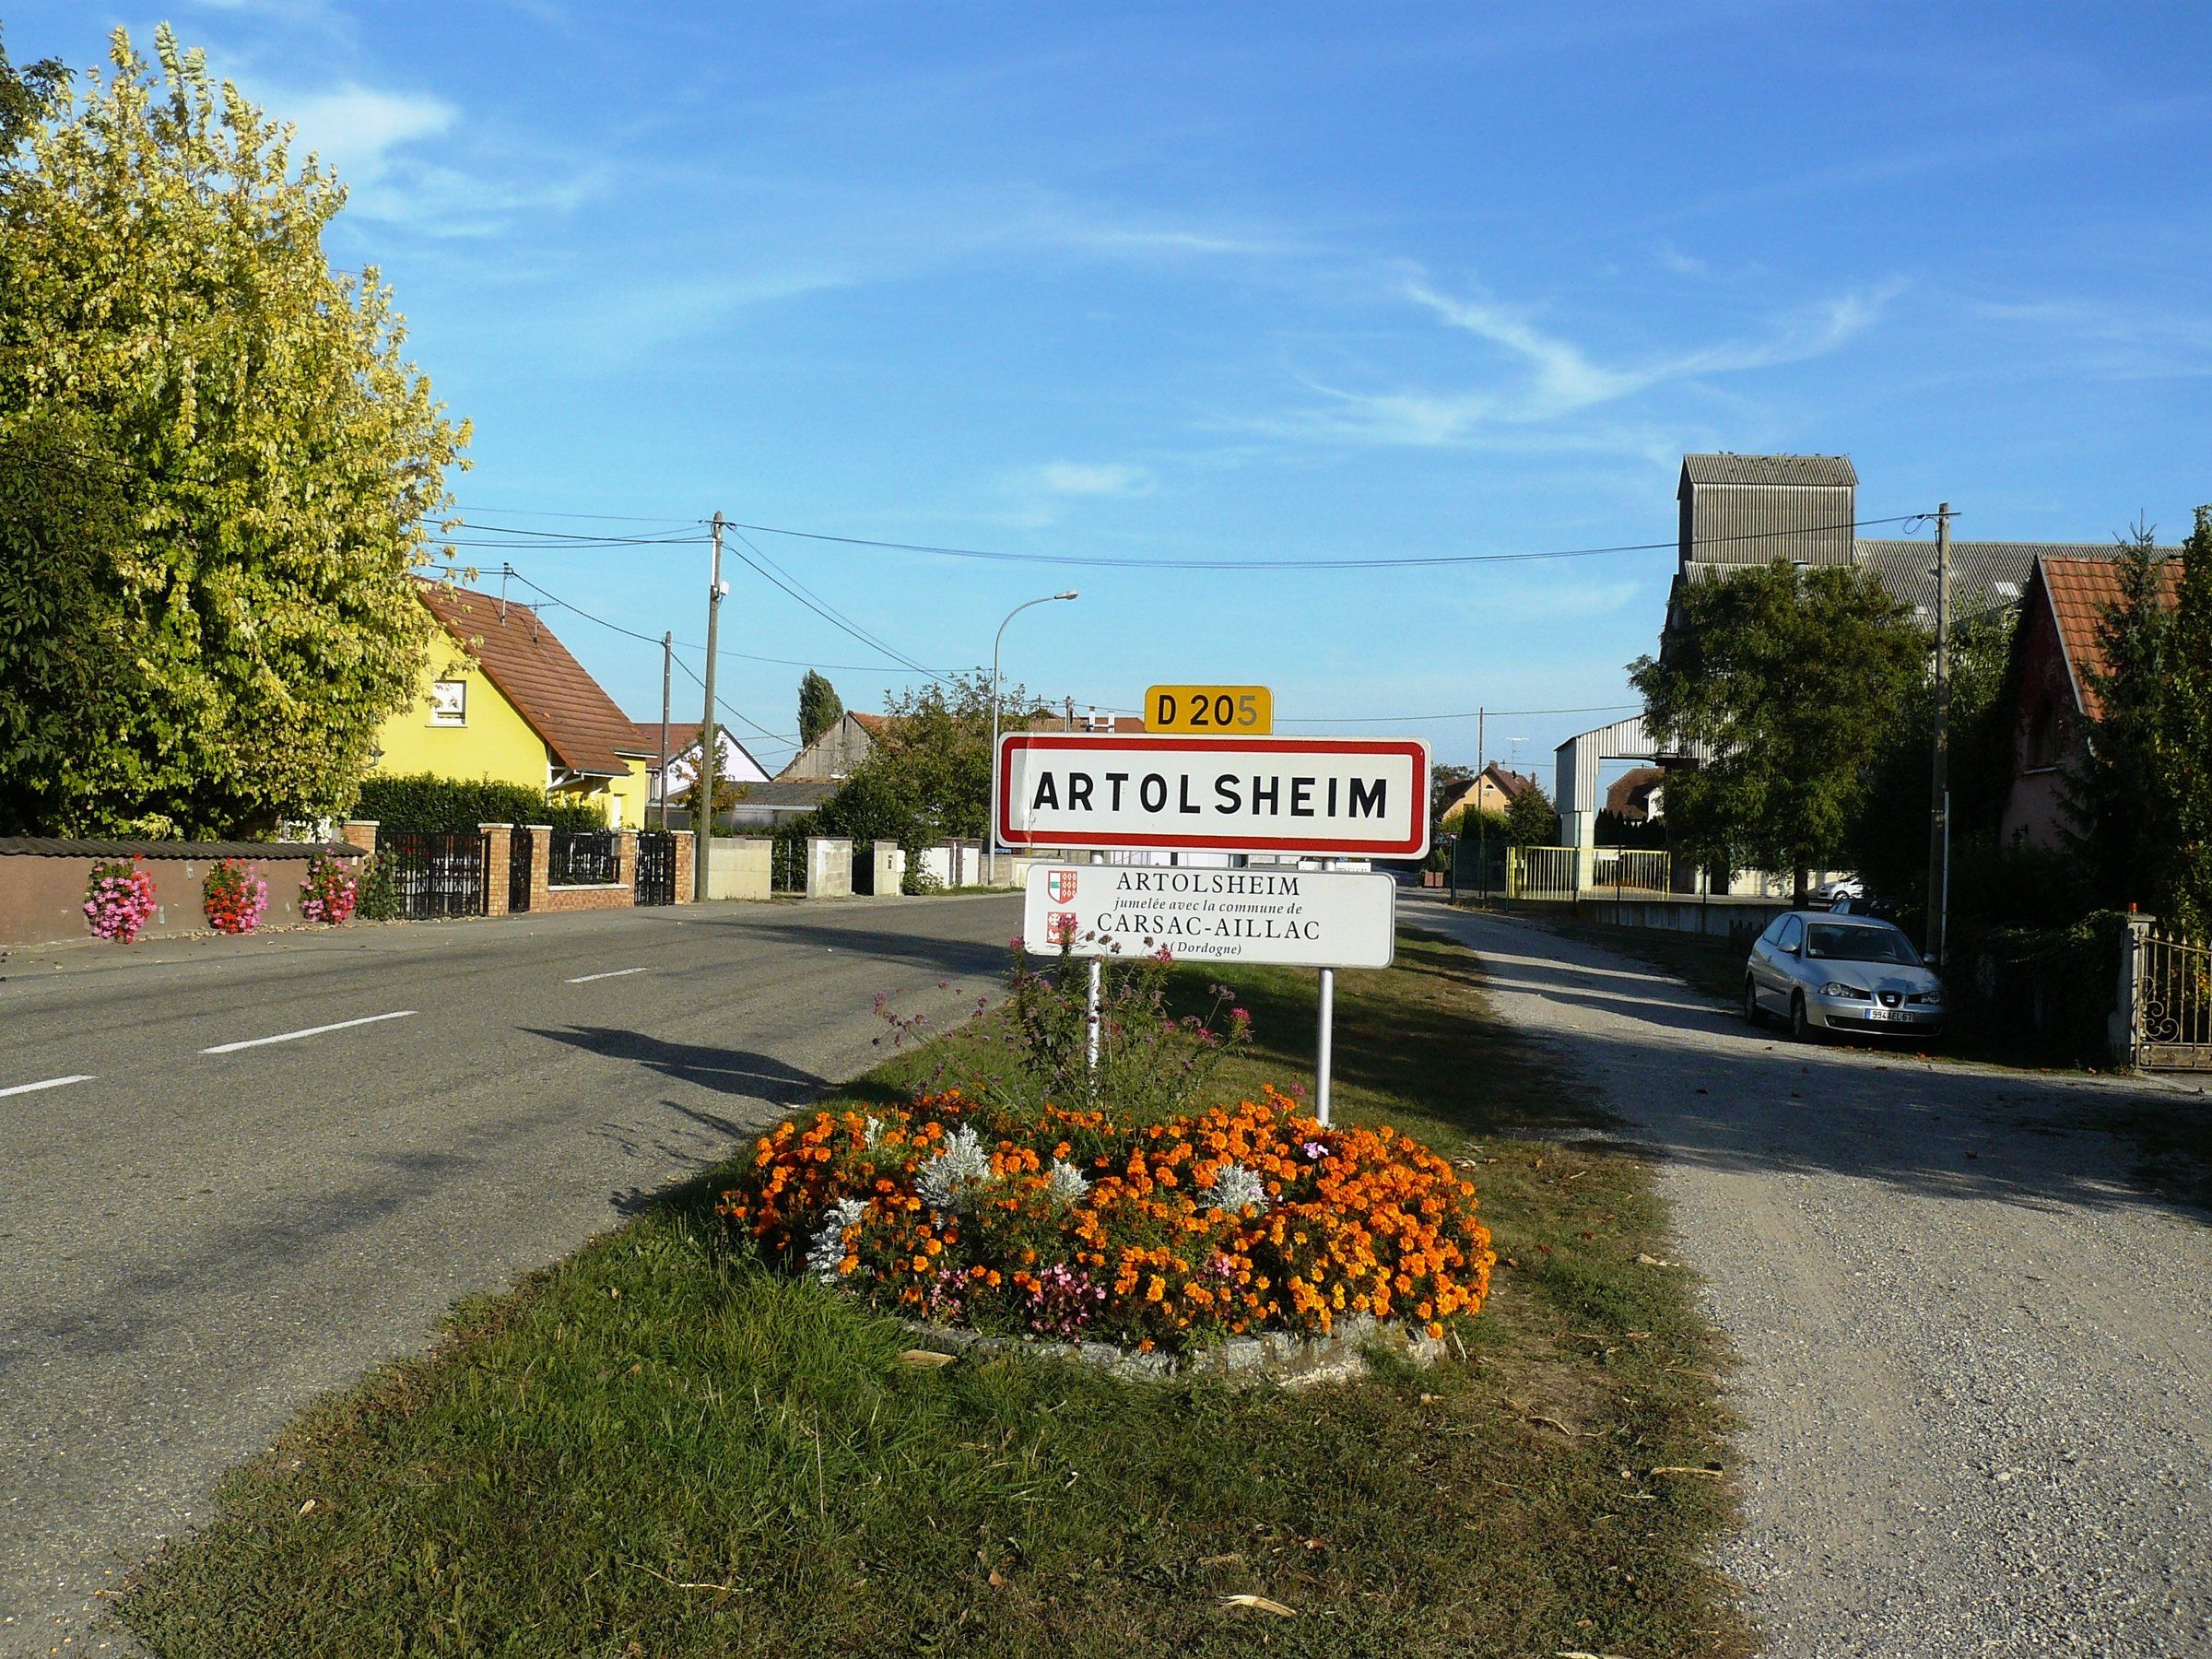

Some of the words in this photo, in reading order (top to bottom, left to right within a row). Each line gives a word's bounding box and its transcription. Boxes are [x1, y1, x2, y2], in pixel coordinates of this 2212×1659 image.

[1158, 694, 1176, 725] D
[1190, 694, 1257, 726] 205
[1033, 771, 1387, 818] ARTOLSHEIM
[1116, 872, 1300, 896] ARTOLSHEIM
[1113, 897, 1166, 912] jumelée
[1169, 901, 1199, 911] avec
[1203, 898, 1216, 912] la
[1218, 903, 1284, 914] commune
[1287, 902, 1303, 915] de
[1097, 912, 1321, 940] CARSAC-AILLAC
[1170, 942, 1242, 956] (Dordogne)
